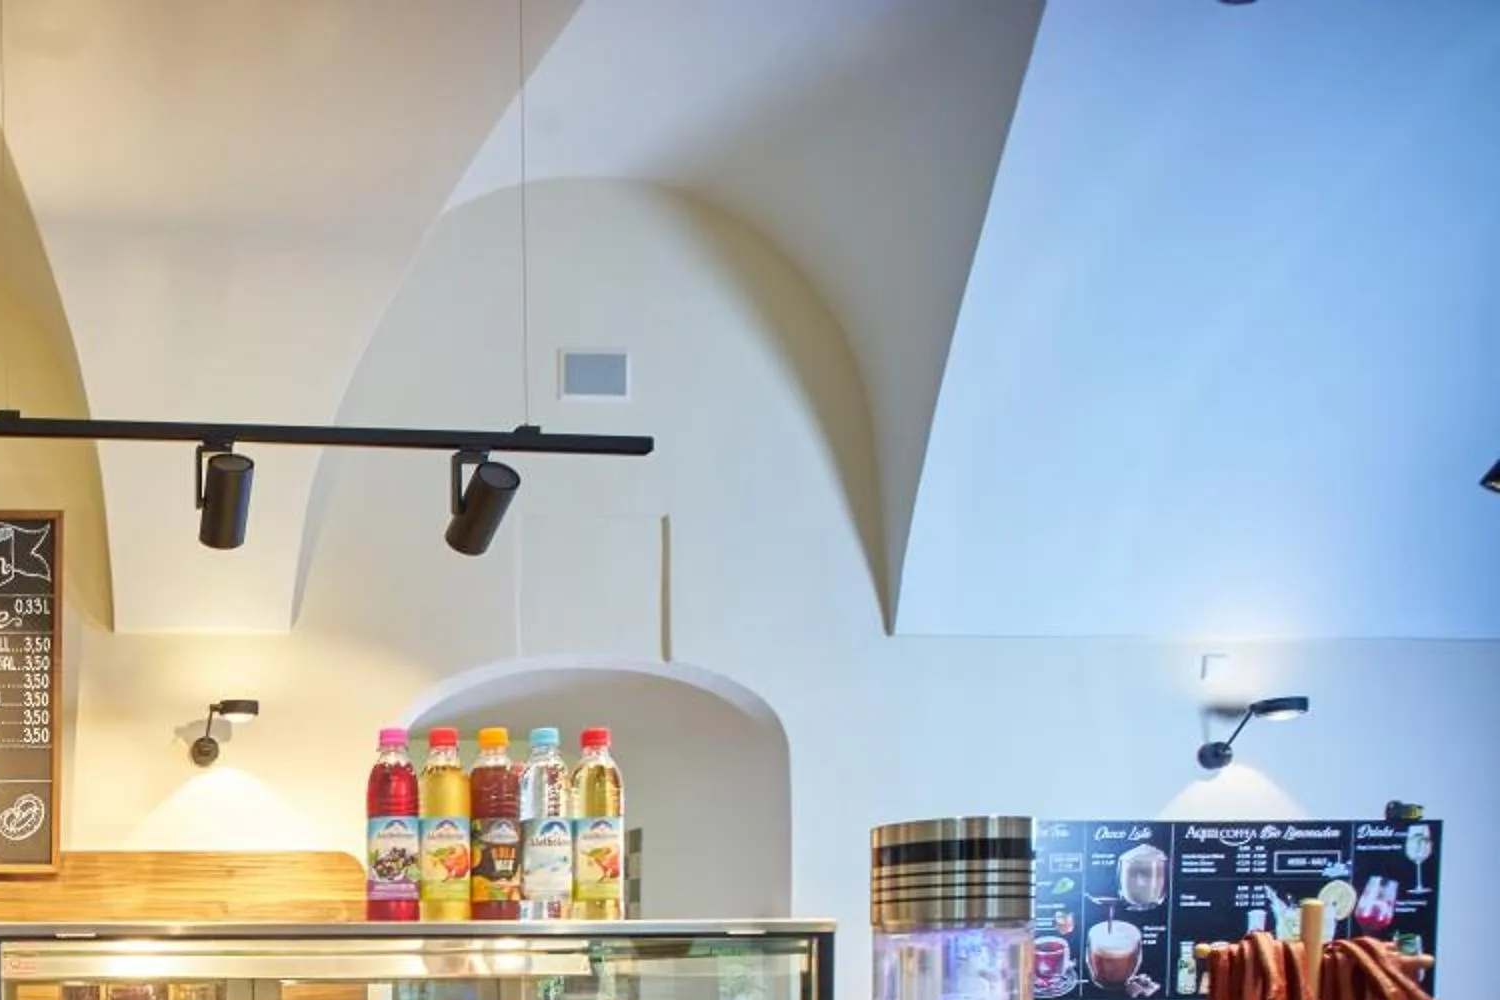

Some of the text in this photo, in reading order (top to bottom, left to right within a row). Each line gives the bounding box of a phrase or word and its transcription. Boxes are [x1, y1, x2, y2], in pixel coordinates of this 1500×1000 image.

[14, 598, 51, 616] 0,33L
[24, 637, 51, 653] 3,50
[24, 655, 49, 671] 3,50
[23, 673, 49, 689] 3,50
[23, 691, 49, 707] 3,50
[23, 709, 49, 725] 3,50
[23, 727, 49, 744] 3,50
